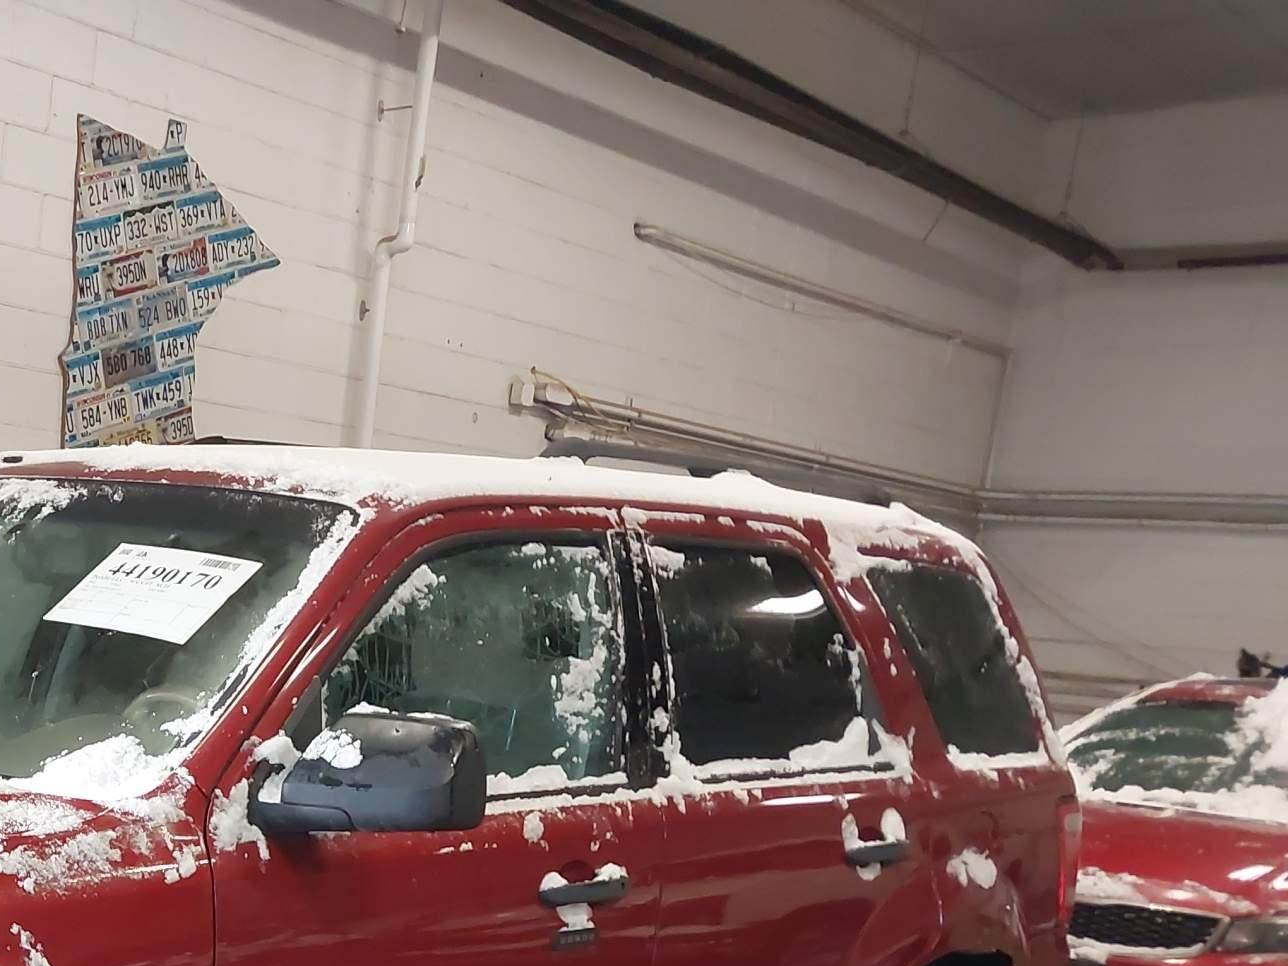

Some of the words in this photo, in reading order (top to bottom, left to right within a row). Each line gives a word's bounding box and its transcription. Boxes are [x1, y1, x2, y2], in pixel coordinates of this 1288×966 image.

[88, 176, 134, 207] 214-YMJ
[141, 170, 161, 192] 940
[179, 205, 198, 228] 369
[100, 224, 121, 249] UXP
[212, 240, 229, 264] ADY
[236, 236, 255, 258] 232
[192, 288, 210, 311] 159
[109, 311, 128, 334] TXN
[138, 305, 160, 328] 524
[160, 338, 179, 360] 448
[134, 388, 156, 412] TWK
[162, 380, 181, 403] 459
[81, 397, 128, 429] 584-YNB
[108, 562, 223, 590] 44190170
